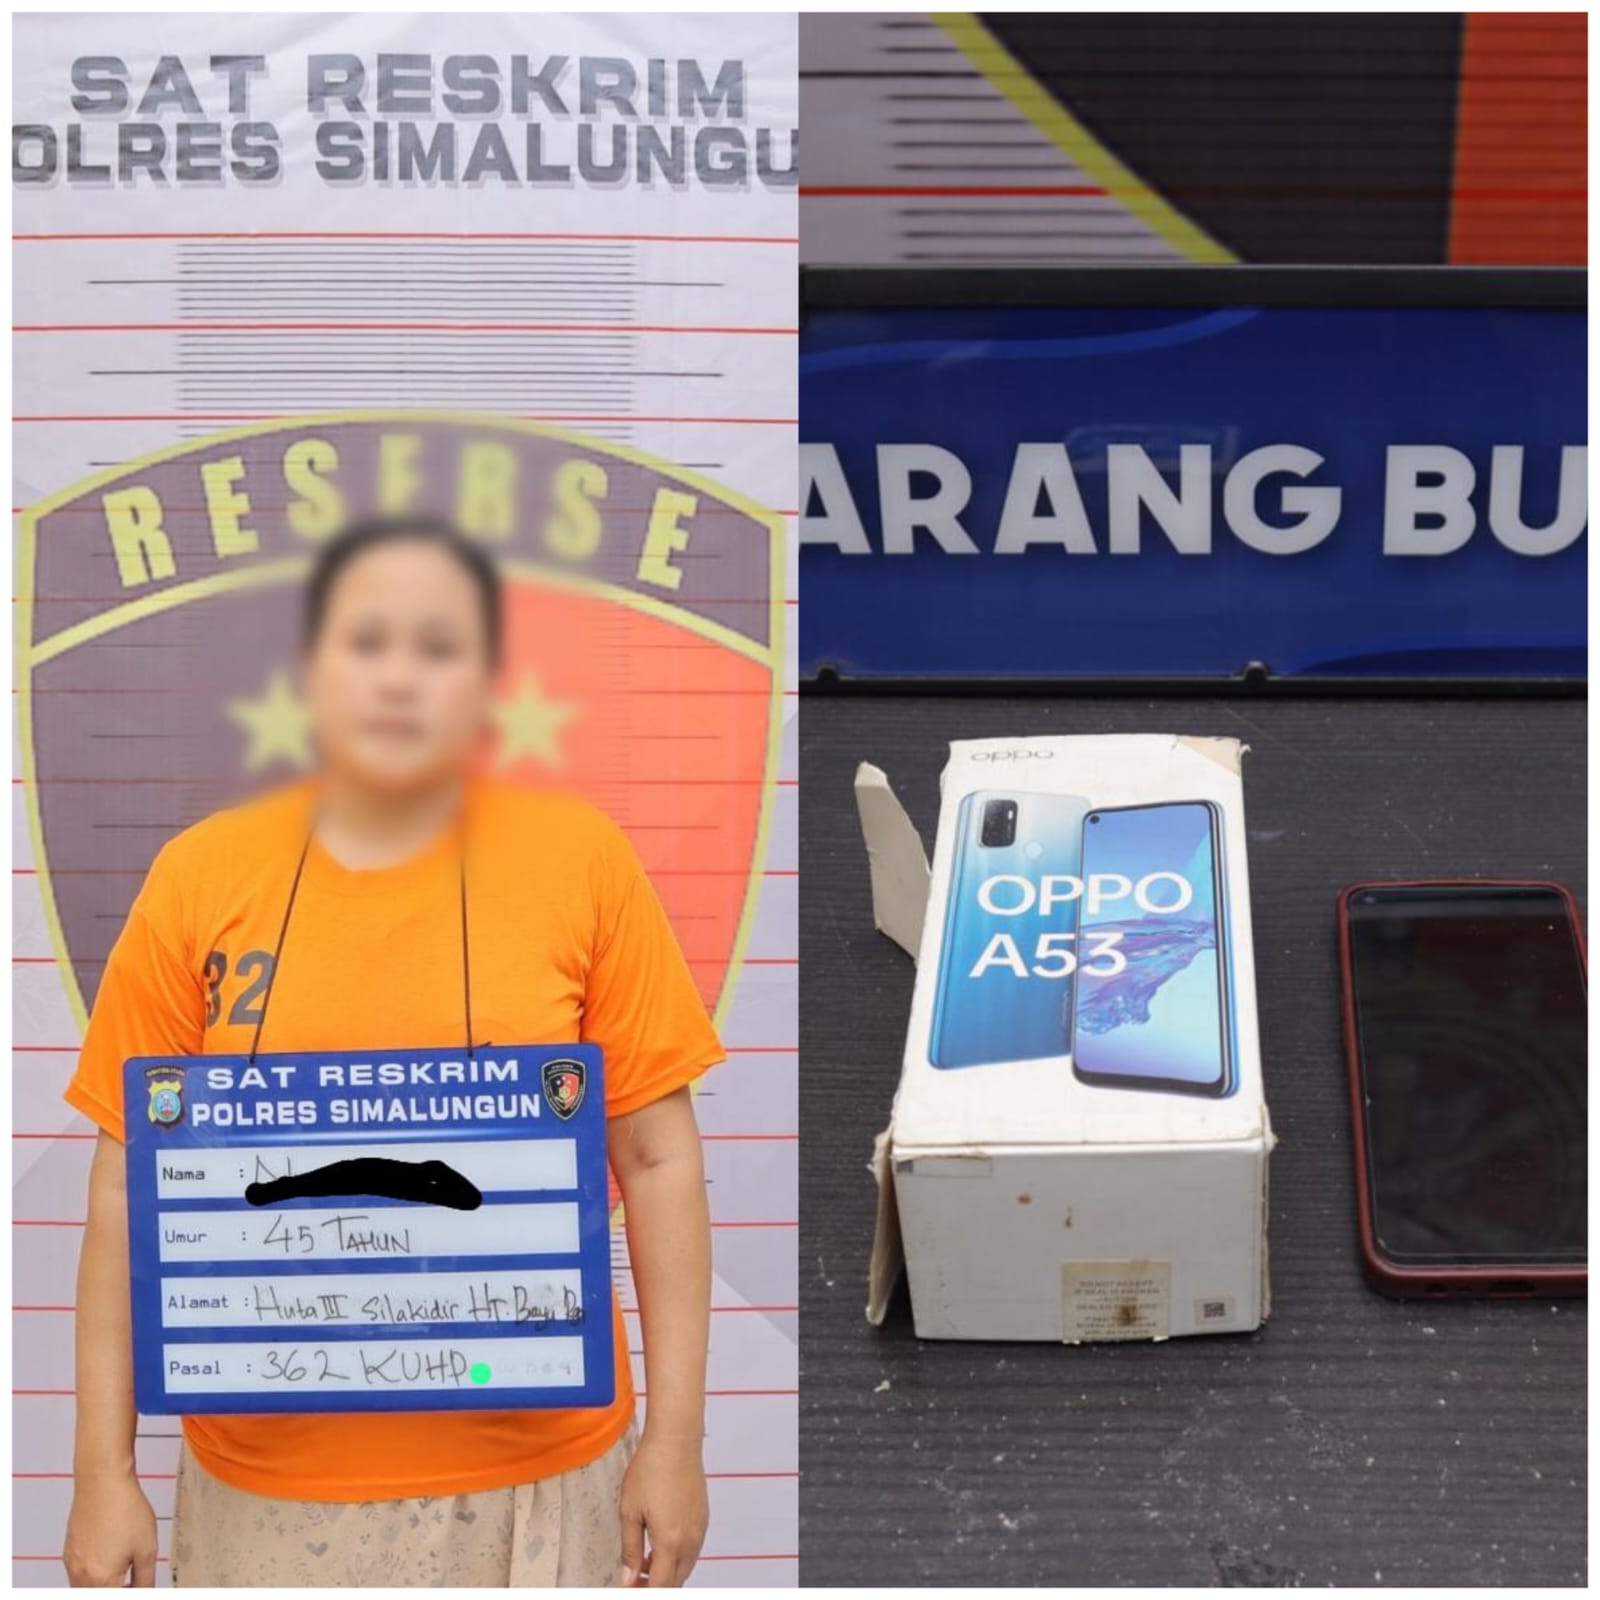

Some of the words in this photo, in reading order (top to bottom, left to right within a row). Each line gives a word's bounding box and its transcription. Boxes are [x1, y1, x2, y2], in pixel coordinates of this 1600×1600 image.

[70, 54, 267, 115] SAT
[306, 53, 745, 120] RESKRIM
[12, 122, 281, 184] OLRES
[315, 121, 799, 186] SIMALUNGU
[798, 442, 1342, 555] ARANG
[1383, 444, 1588, 556] BU
[976, 872, 1194, 916] OPPO
[969, 932, 1129, 979] A53
[203, 950, 276, 1029] 32
[207, 1066, 297, 1091] SAT
[319, 1059, 519, 1087] RESKRIM
[192, 1101, 318, 1128] POLRES
[330, 1094, 540, 1124] SIMALUNGUN
[162, 1166, 206, 1182] Nama
[164, 1229, 208, 1245] Umur
[263, 1213, 315, 1254] 45
[321, 1215, 412, 1255] TAHUN
[167, 1294, 230, 1310] Alamat
[253, 1285, 318, 1322] Huta
[316, 1294, 349, 1322] III
[169, 1360, 222, 1376] Pasal
[261, 1349, 351, 1382] 362
[359, 1348, 467, 1388] KUHP
